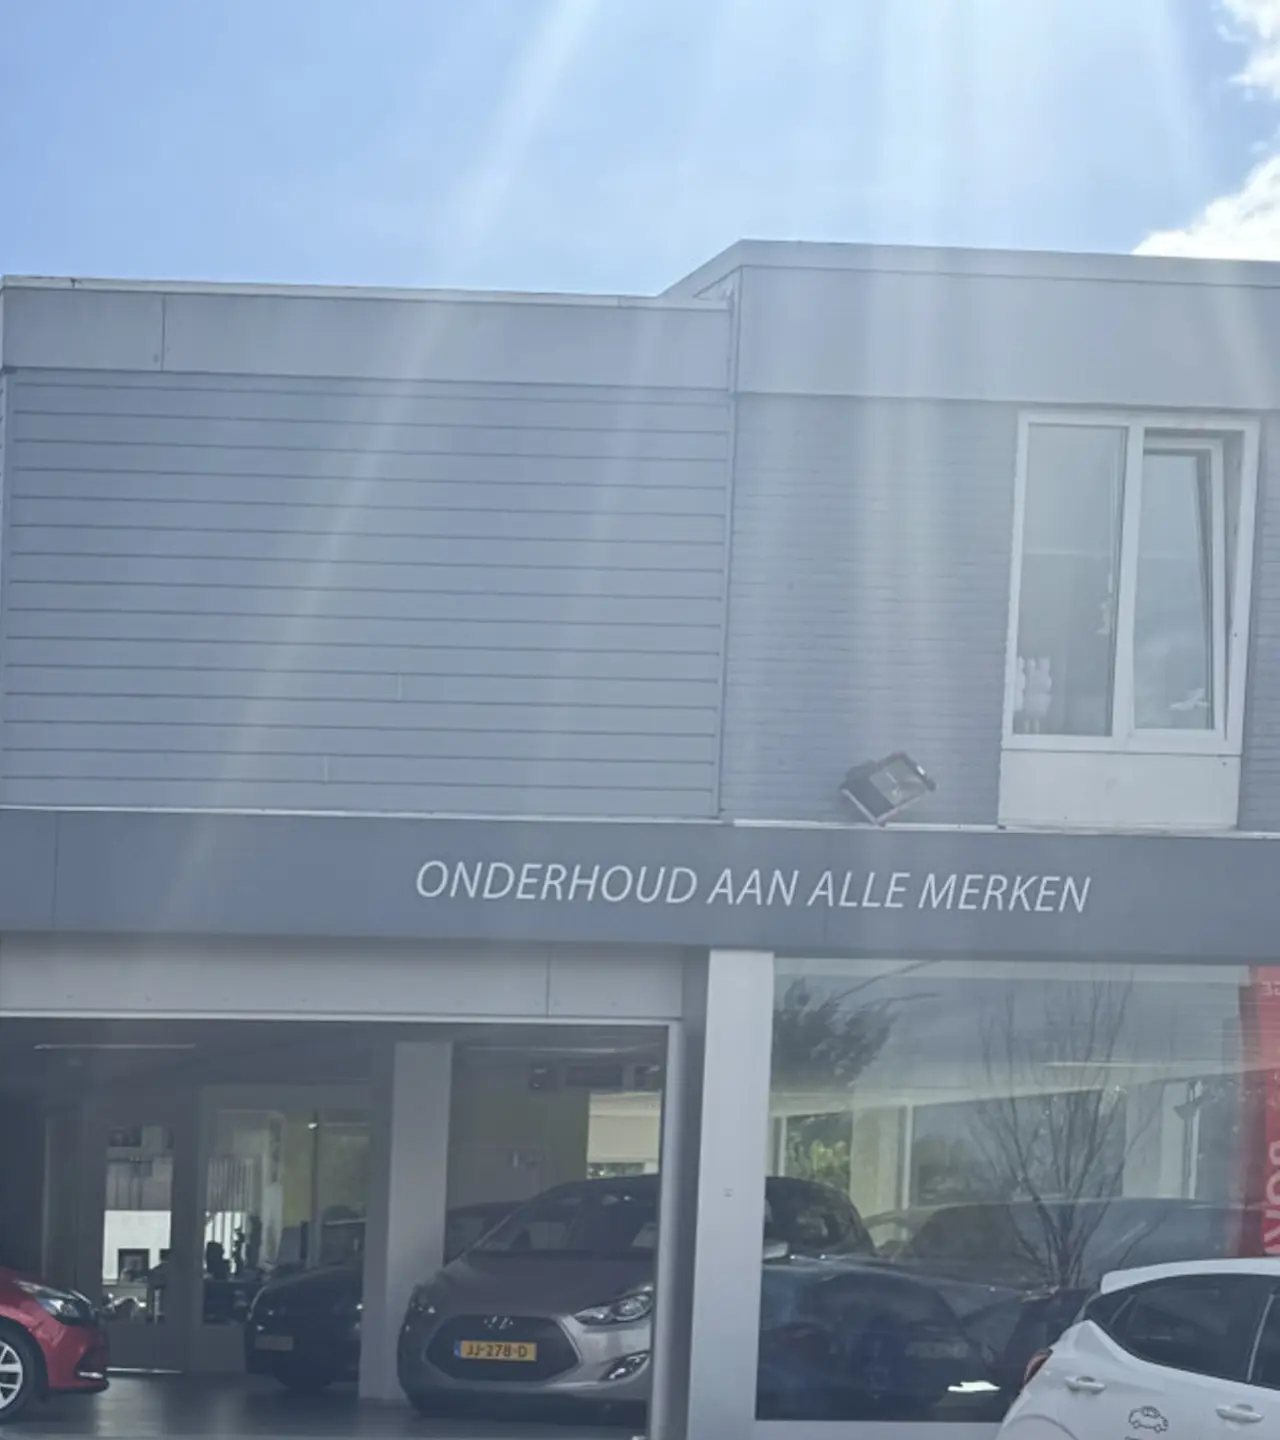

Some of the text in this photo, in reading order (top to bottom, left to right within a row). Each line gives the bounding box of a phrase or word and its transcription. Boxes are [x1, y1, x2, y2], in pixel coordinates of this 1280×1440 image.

[416, 860, 1092, 914] ONDERHOUD AAN ALLE MERKEN
